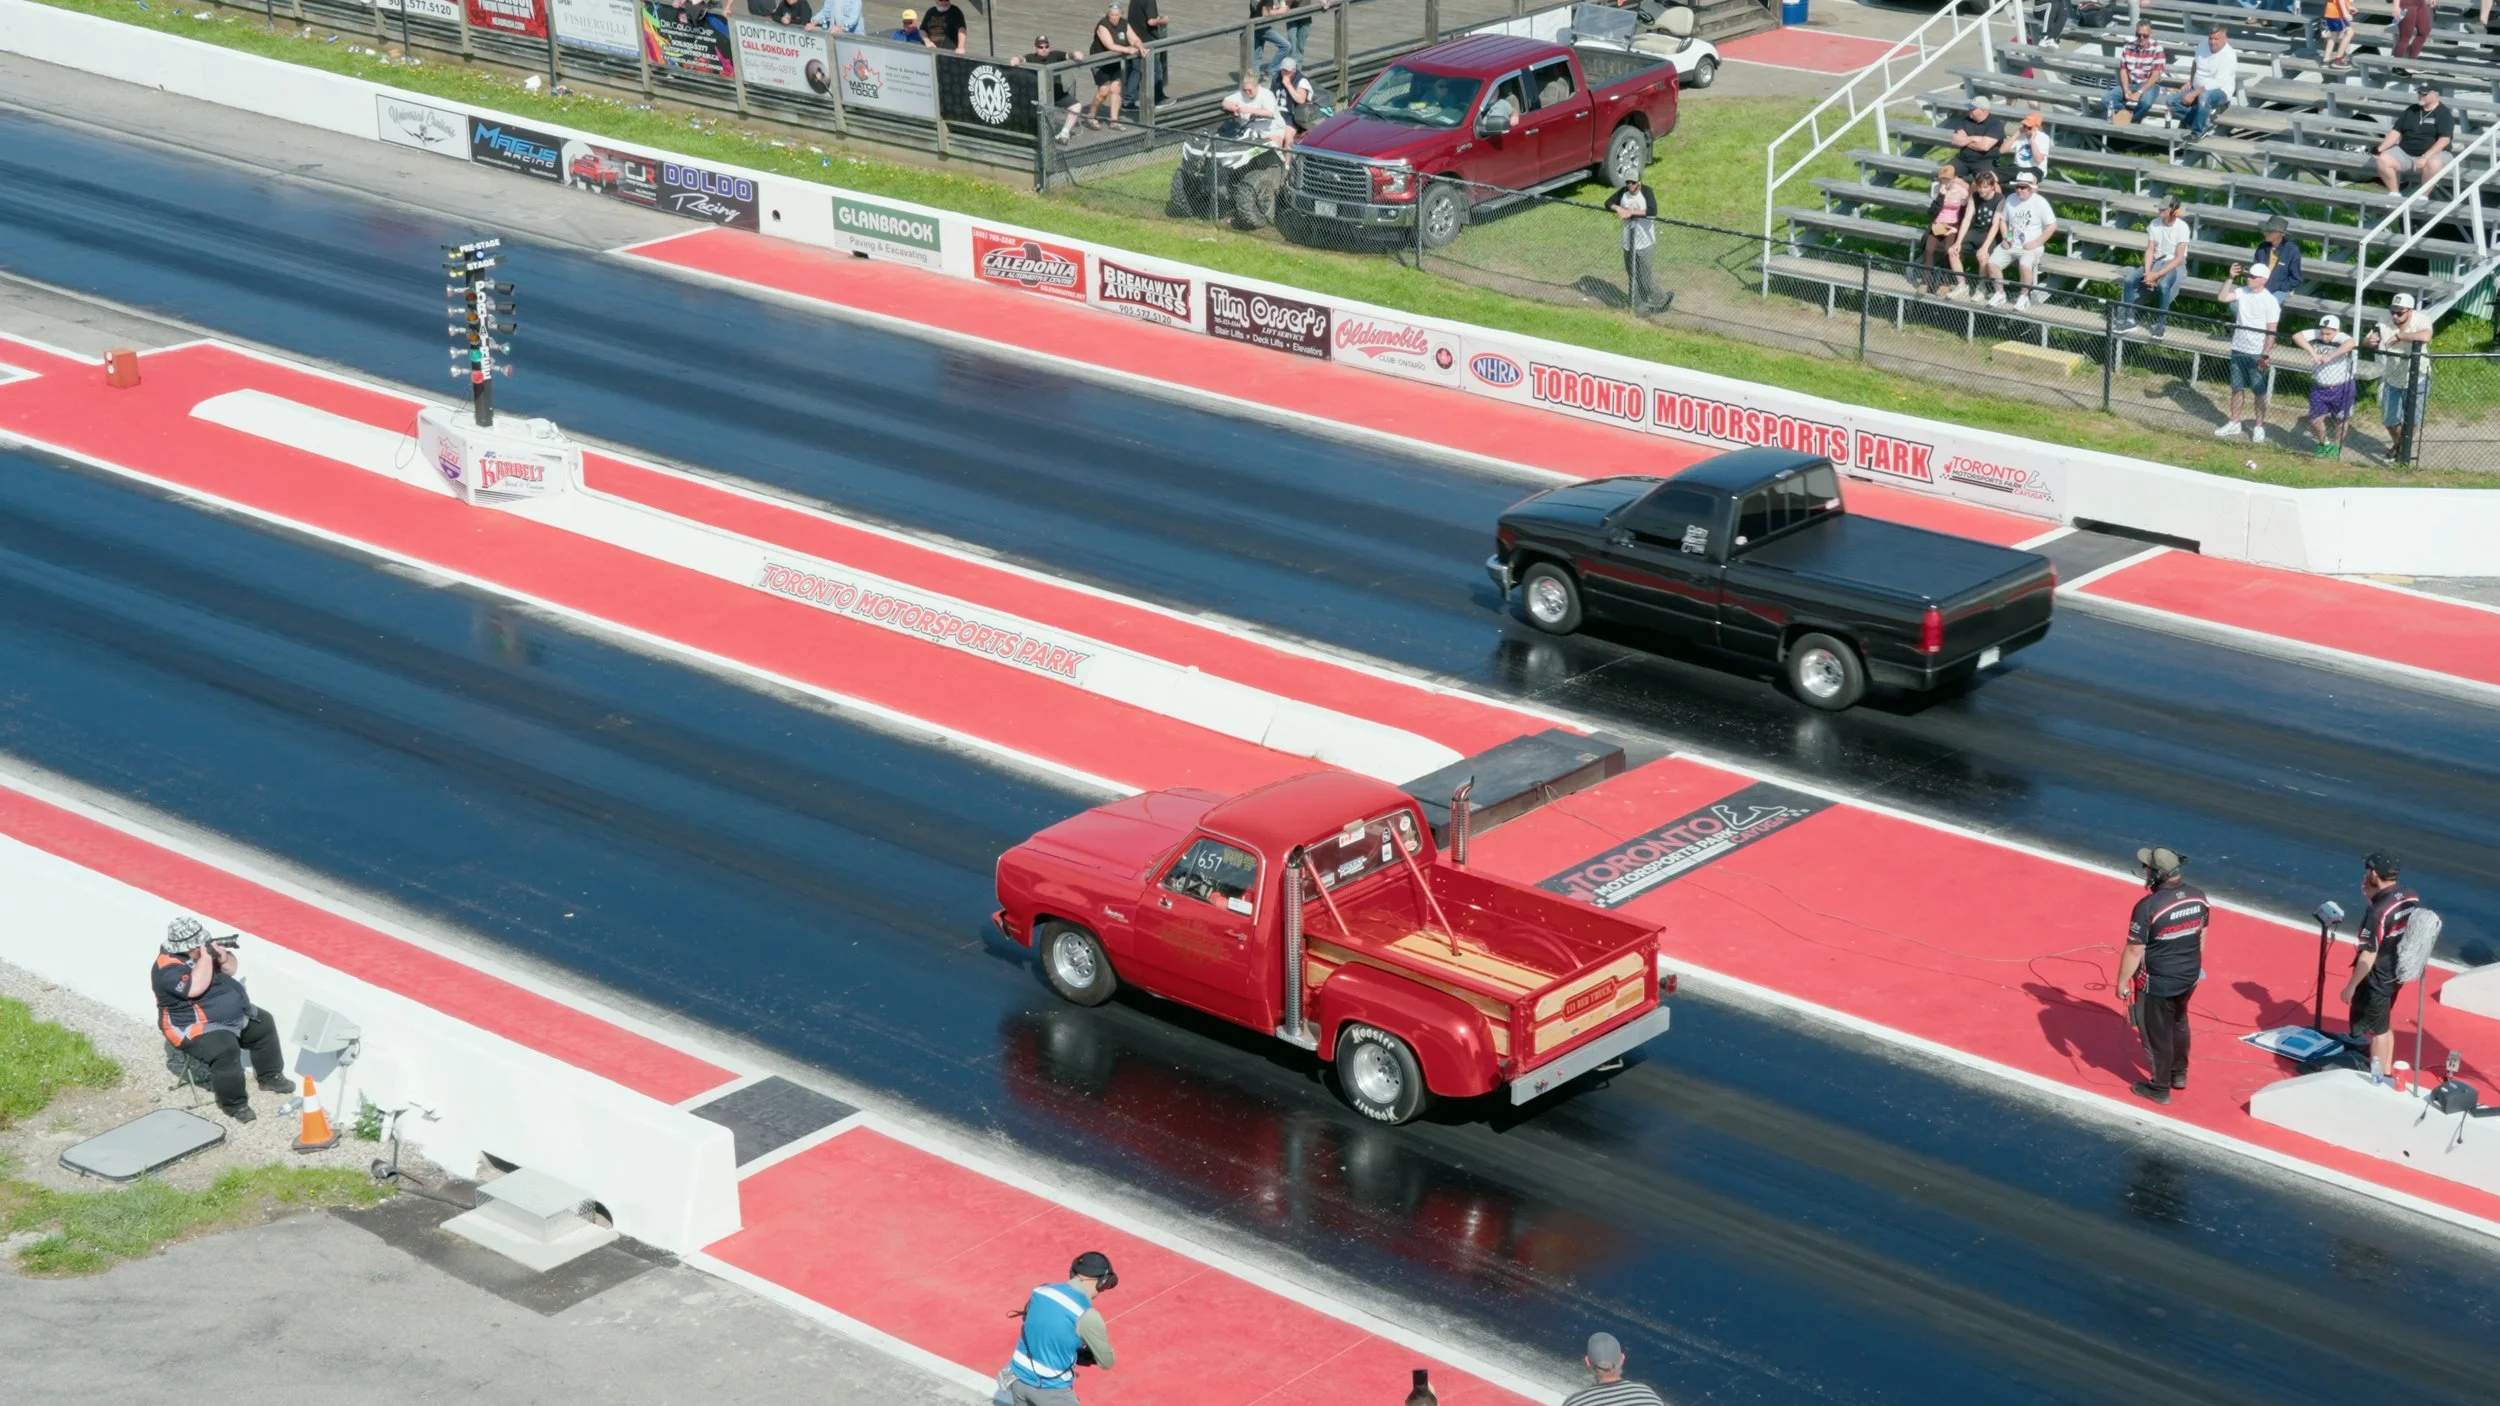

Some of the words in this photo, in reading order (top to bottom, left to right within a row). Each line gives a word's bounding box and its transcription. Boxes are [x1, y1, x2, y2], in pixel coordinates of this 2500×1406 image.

[740, 25, 766, 40] DON'T
[769, 30, 786, 43] PUT
[789, 34, 796, 45] IT
[742, 40, 760, 51] CALL
[761, 44, 800, 58] SOKOLOFF
[968, 74, 977, 91] ONE
[972, 65, 993, 78] WHEEL
[994, 69, 1012, 98] MAFIA
[849, 80, 878, 91] MATCO
[851, 88, 879, 99] TOOLS
[969, 96, 991, 123] HARLEY
[991, 102, 1012, 124] STUNTS
[474, 122, 558, 163] MATEUS
[503, 151, 555, 168] RACING
[663, 162, 752, 202] DOLDO
[670, 193, 741, 222] Racing
[838, 206, 933, 243] GLANBROOK
[459, 238, 500, 253] PRE-STAGE
[849, 236, 875, 251] Paving
[877, 241, 884, 252] &
[885, 243, 928, 263] Excavating
[467, 258, 496, 271] STAGE
[983, 255, 1076, 277] CALEDONIA
[1007, 271, 1048, 282] AUTOMOTIVE
[1104, 265, 1186, 300] BREAKAWAY
[1104, 284, 1140, 300] AUTO
[1145, 294, 1187, 316] GLASS
[1210, 287, 1250, 328] Tim
[1251, 296, 1326, 337] Orser's
[1119, 305, 1171, 324] 905.577.5120
[1215, 326, 1230, 335] Stair
[1231, 328, 1244, 339] Lifts
[1252, 334, 1269, 345] Deck
[1270, 337, 1284, 348] Lifts
[1293, 343, 1323, 356] Elevators
[1262, 327, 1276, 336] LIFT
[1276, 329, 1305, 341] SERVICE
[1335, 319, 1428, 351] Oldsmobile
[1379, 355, 1396, 364] CLUB
[1398, 359, 1426, 371] ONTARIO
[1476, 358, 1516, 383] NHRA
[1532, 363, 1644, 421] TORONTO
[1655, 390, 1848, 464] MOTORSPORTS
[1856, 431, 1933, 483] PARK
[1952, 456, 2027, 483] TORONTO
[1952, 469, 2003, 485] MOTORSPORTS
[2004, 480, 2023, 489] PARK
[2014, 488, 2044, 500] CAYUGA
[760, 564, 857, 609] TORONTO
[854, 590, 1021, 660] MOTORSPORTS
[1015, 638, 1090, 678] PARK
[1728, 815, 1791, 845] CAYUGA
[1562, 817, 1723, 890] TORONTO
[1594, 843, 1701, 896] MOTORSPORTS
[1699, 827, 1739, 850] PARK
[2170, 905, 2200, 920] OFFICIAL
[1352, 1028, 1395, 1050] Hoosier
[1354, 1099, 1399, 1122] Hoosier
